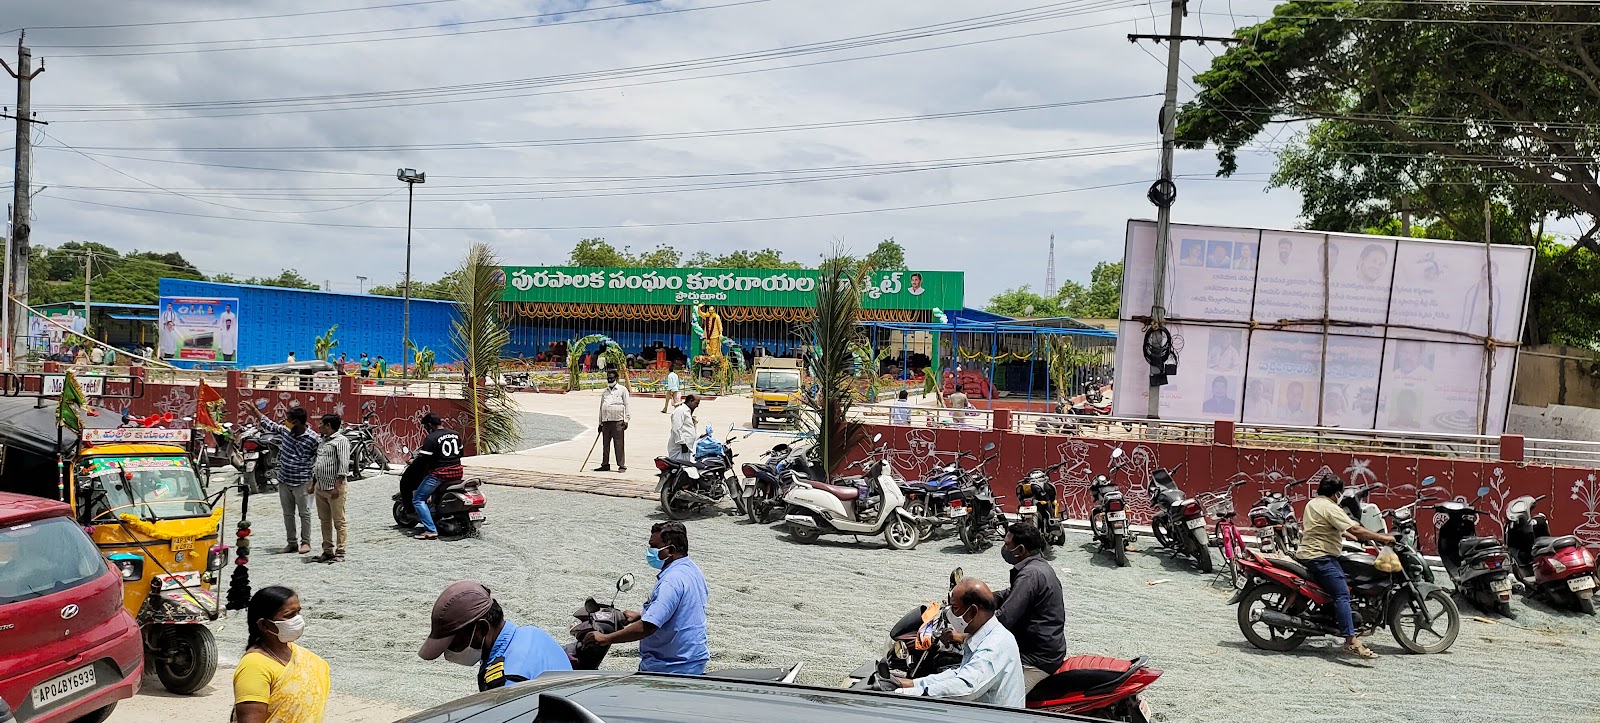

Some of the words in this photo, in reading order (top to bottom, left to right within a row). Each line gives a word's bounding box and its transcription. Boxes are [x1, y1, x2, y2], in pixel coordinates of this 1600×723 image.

[511, 269, 605, 291] పురపాలక
[608, 270, 683, 292] సంఘం
[686, 272, 815, 292] కూరగాయల
[442, 438, 460, 457] 01
[40, 668, 95, 702] AP04BY6939
